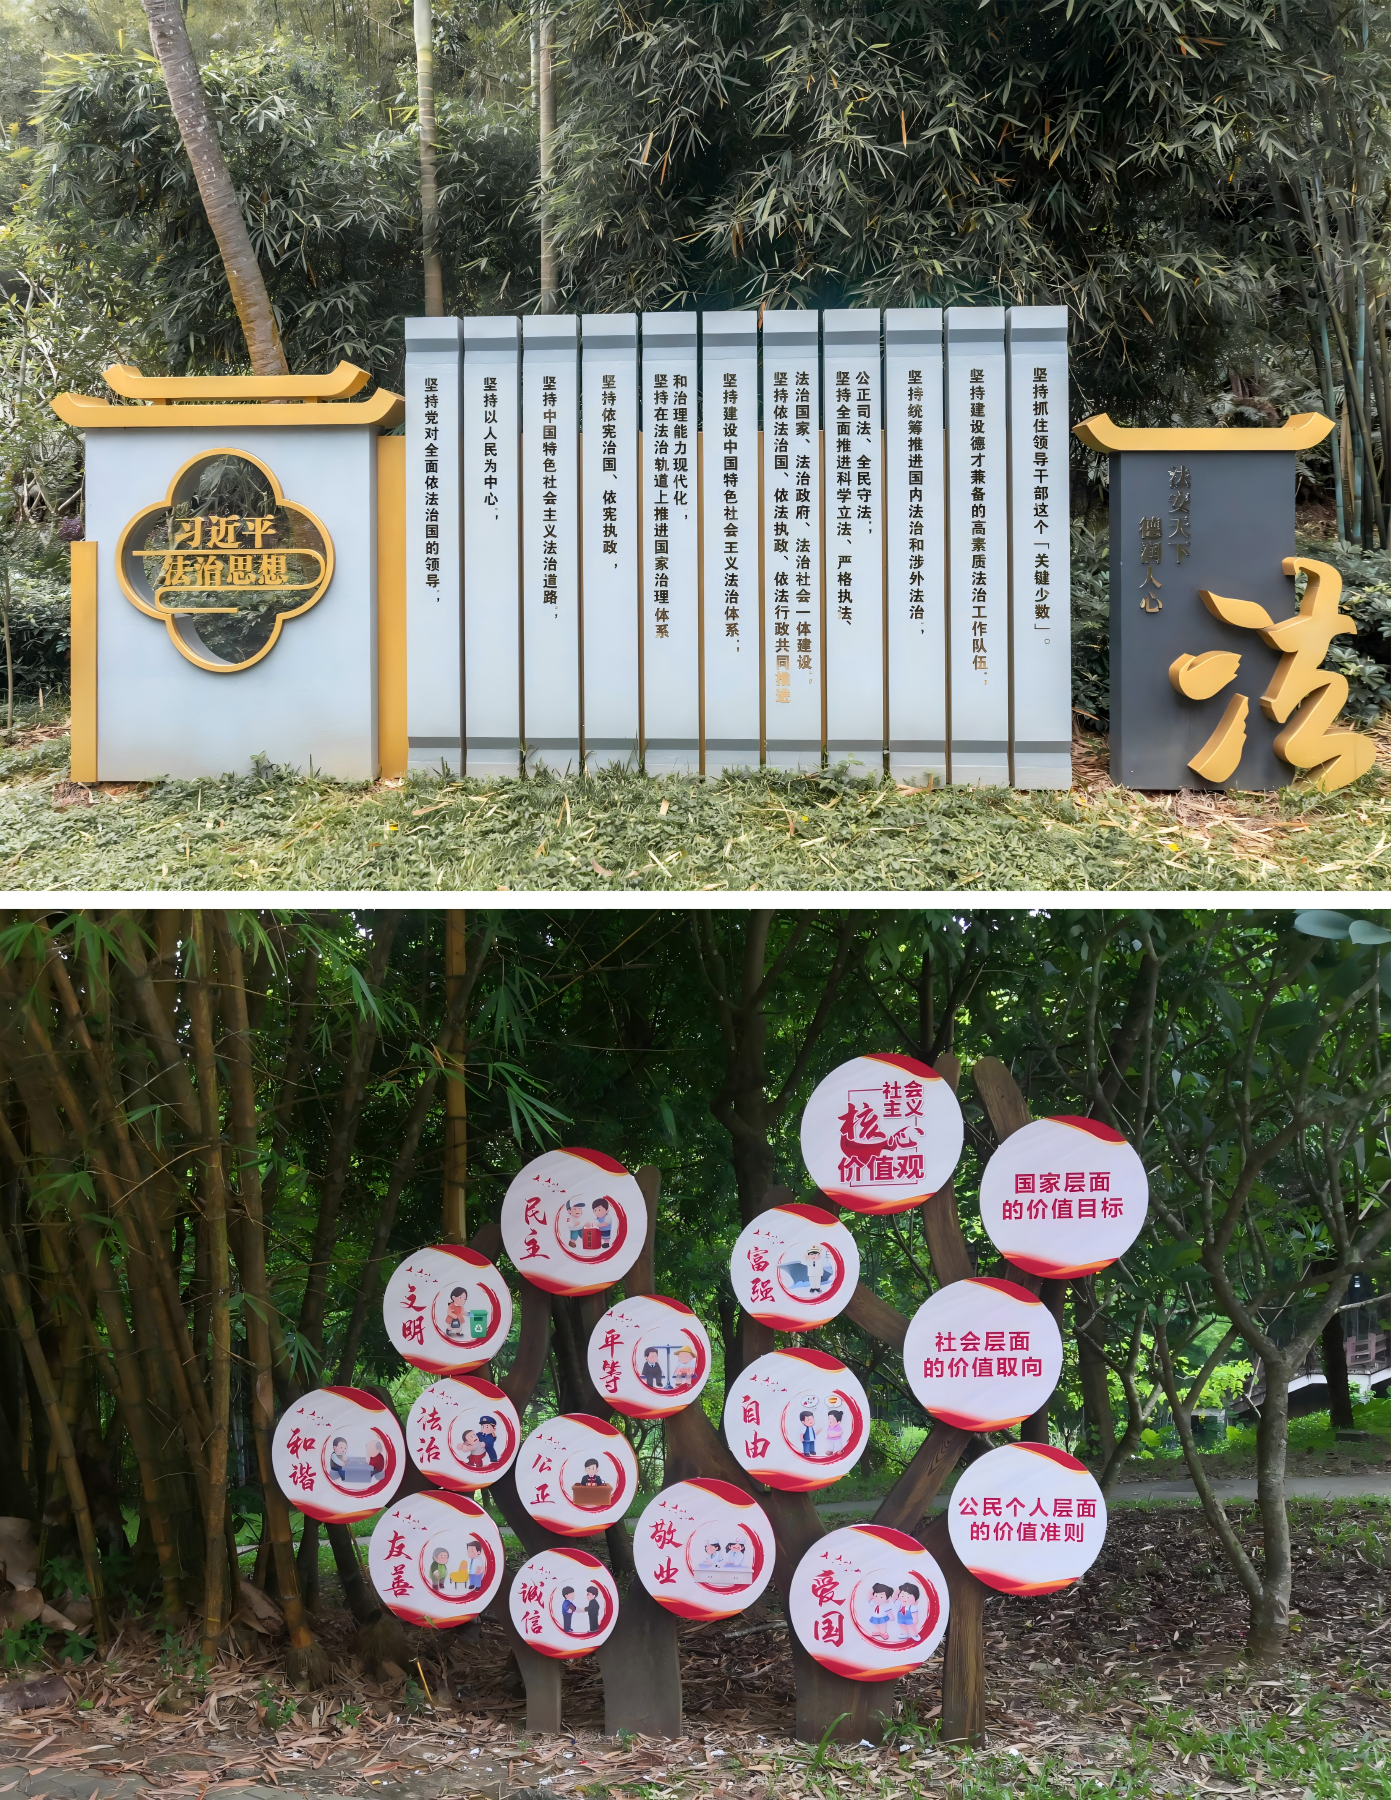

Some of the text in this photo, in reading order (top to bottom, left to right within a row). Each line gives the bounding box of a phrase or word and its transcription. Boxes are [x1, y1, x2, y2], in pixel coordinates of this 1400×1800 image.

[175, 514, 277, 549] 习近平
[653, 373, 670, 639] 坚持在法治轨道上推进国家治理体系
[164, 553, 289, 586] 法治思想
[1138, 516, 1163, 613] 德润人心
[1168, 557, 1376, 792] 法
[882, 1080, 924, 1099] 社会
[882, 1099, 924, 1118] 主义
[837, 1102, 925, 1151] 核心
[837, 1154, 925, 1183] 价值观
[1014, 1171, 1111, 1194] 国家层面
[519, 1196, 550, 1261] 民主
[1002, 1197, 1124, 1221] 的价值目标
[746, 1246, 776, 1303] 富强
[400, 1283, 427, 1346] 文明
[934, 1330, 1031, 1353] 社会层面
[598, 1328, 625, 1394] 平等
[923, 1356, 1043, 1379] 的价值取向
[417, 1406, 443, 1464] 法治
[741, 1394, 771, 1460] 自由
[286, 1428, 317, 1492] 和谐
[530, 1453, 556, 1506] 公正
[958, 1496, 1098, 1519] 公民个人层面
[970, 1521, 1085, 1543] 的价值准则
[382, 1529, 414, 1599] 友善
[649, 1518, 683, 1586] 敬业
[519, 1580, 546, 1636] 诚信
[811, 1569, 847, 1648] 爱国
